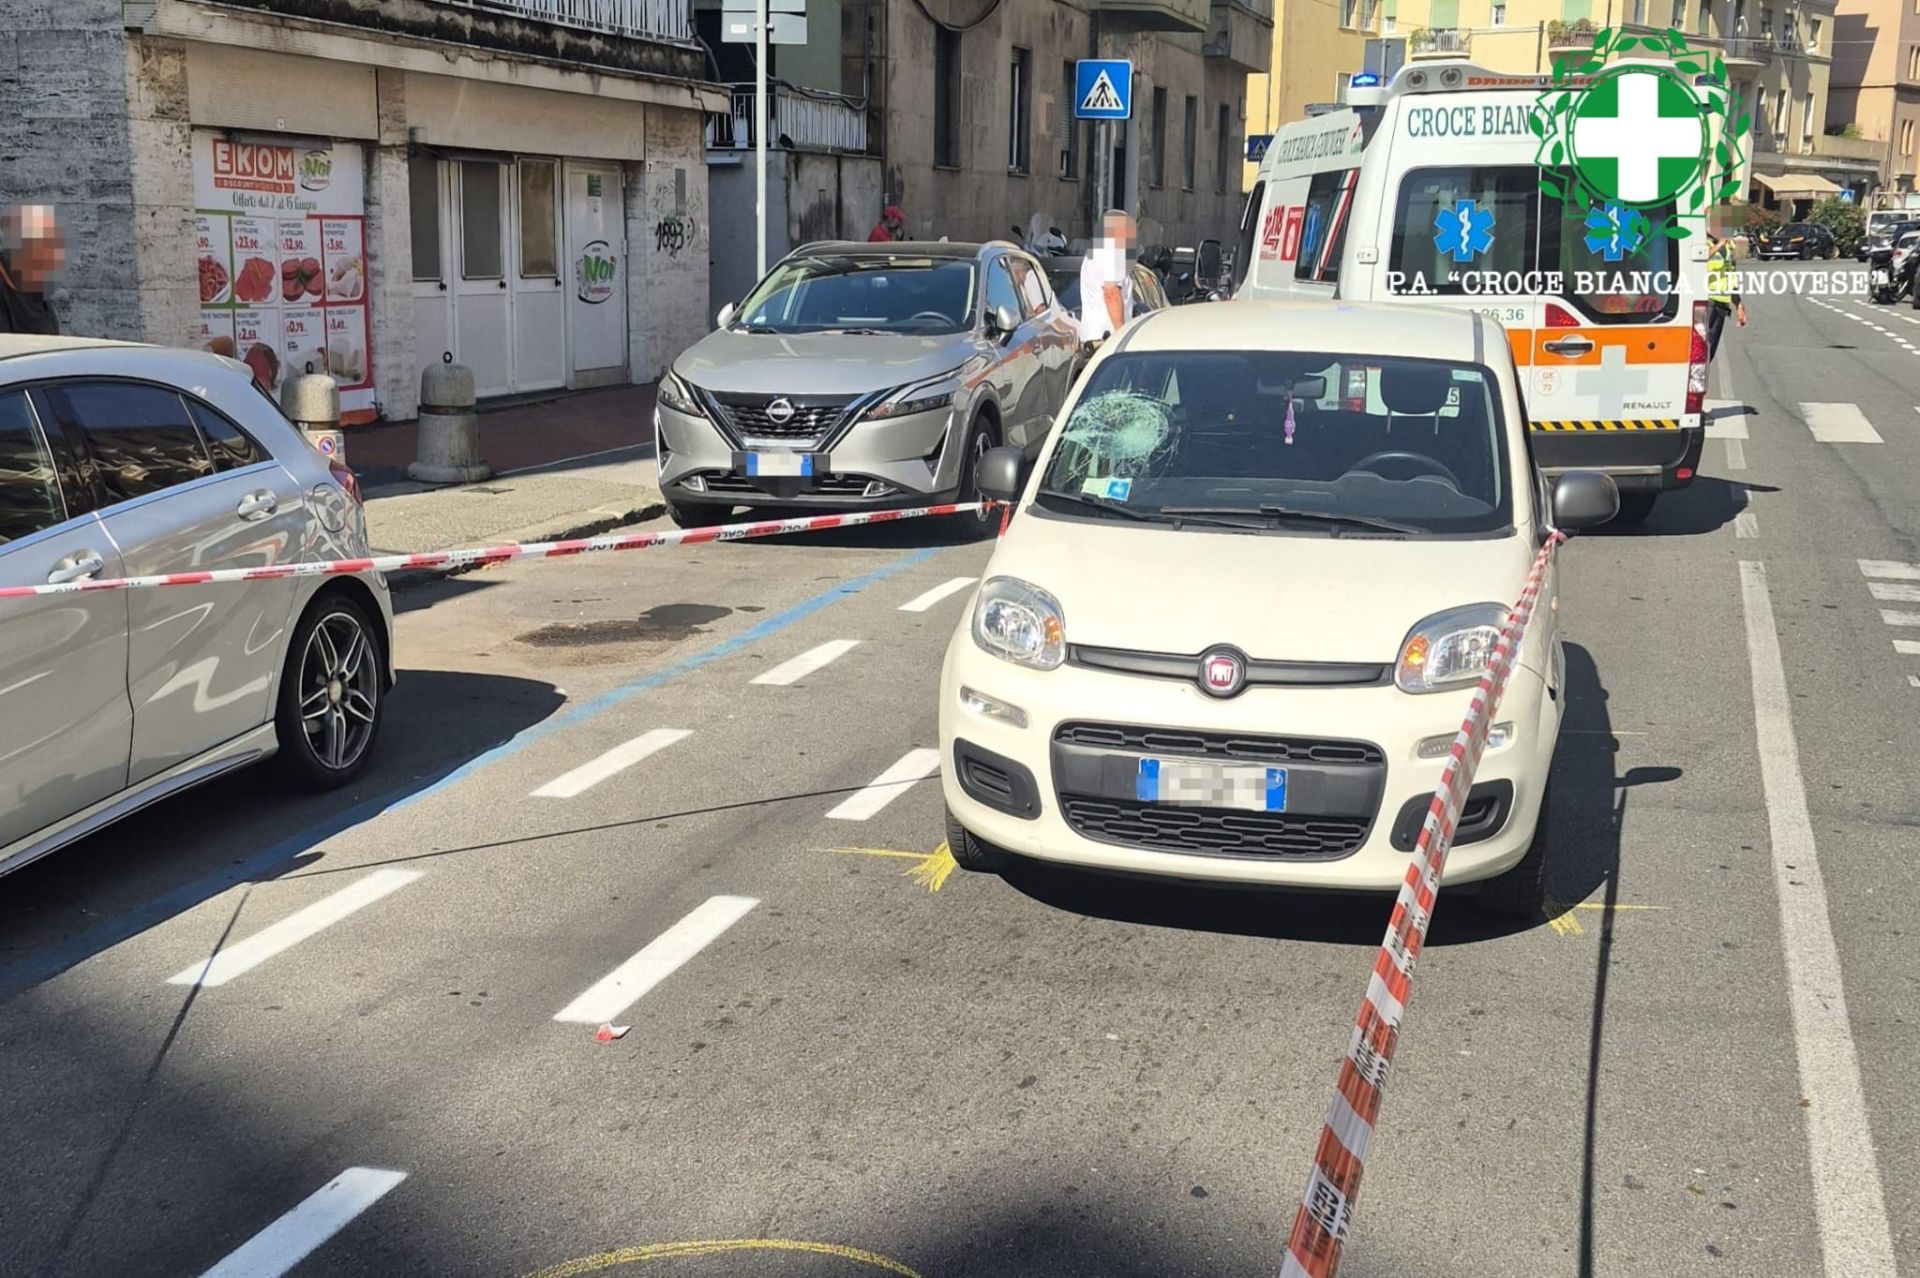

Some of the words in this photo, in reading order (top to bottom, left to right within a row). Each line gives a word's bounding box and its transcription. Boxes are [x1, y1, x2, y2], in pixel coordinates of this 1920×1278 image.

[1407, 107, 1476, 137] CROCE
[215, 142, 293, 177] EKOM
[583, 254, 616, 282] Noi
[1623, 401, 1672, 410] RENAULT
